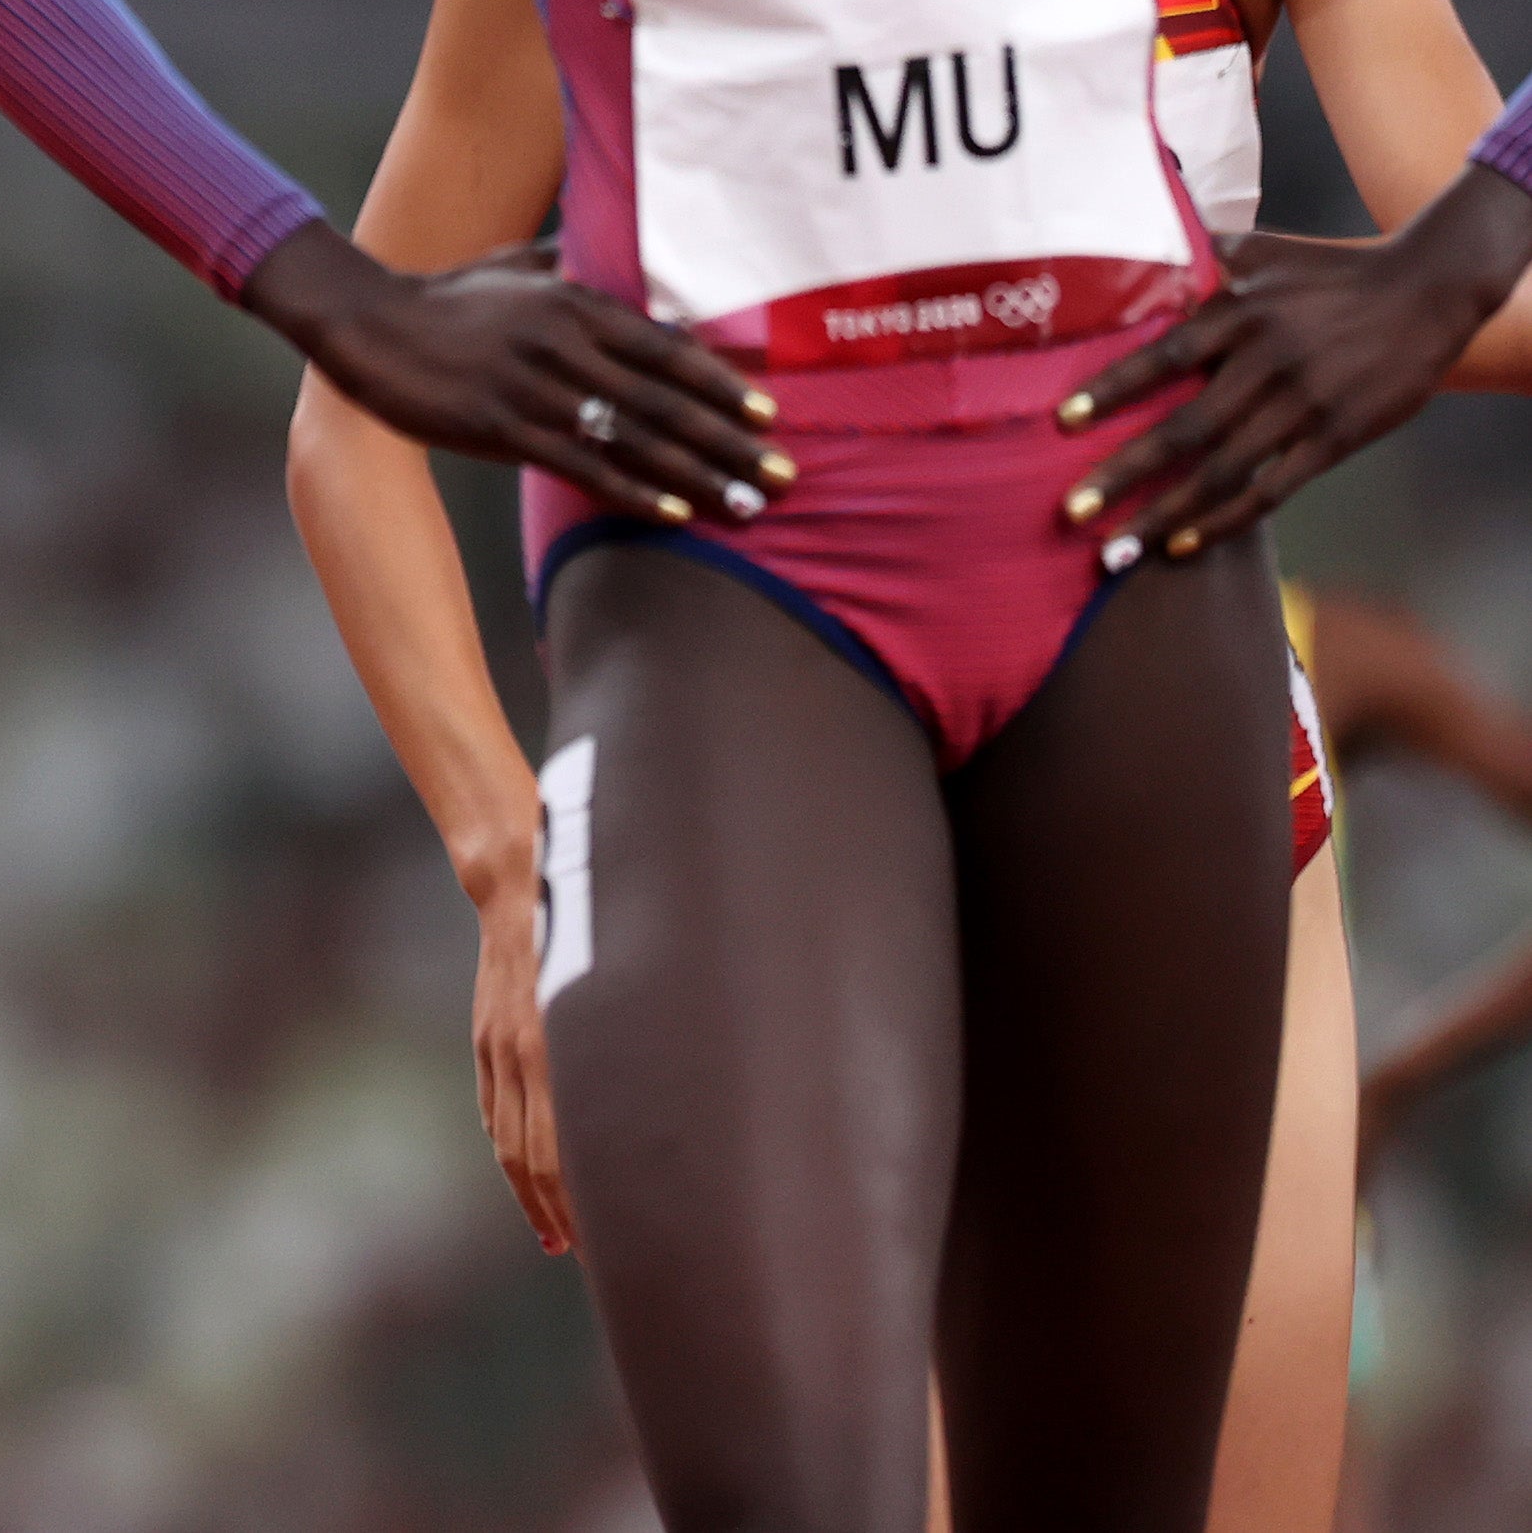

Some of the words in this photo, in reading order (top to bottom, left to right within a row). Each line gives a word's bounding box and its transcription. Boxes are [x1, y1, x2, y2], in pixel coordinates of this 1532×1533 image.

[834, 45, 1022, 176] MU
[823, 299, 913, 343] TOKYO
[914, 292, 984, 333] 2020
